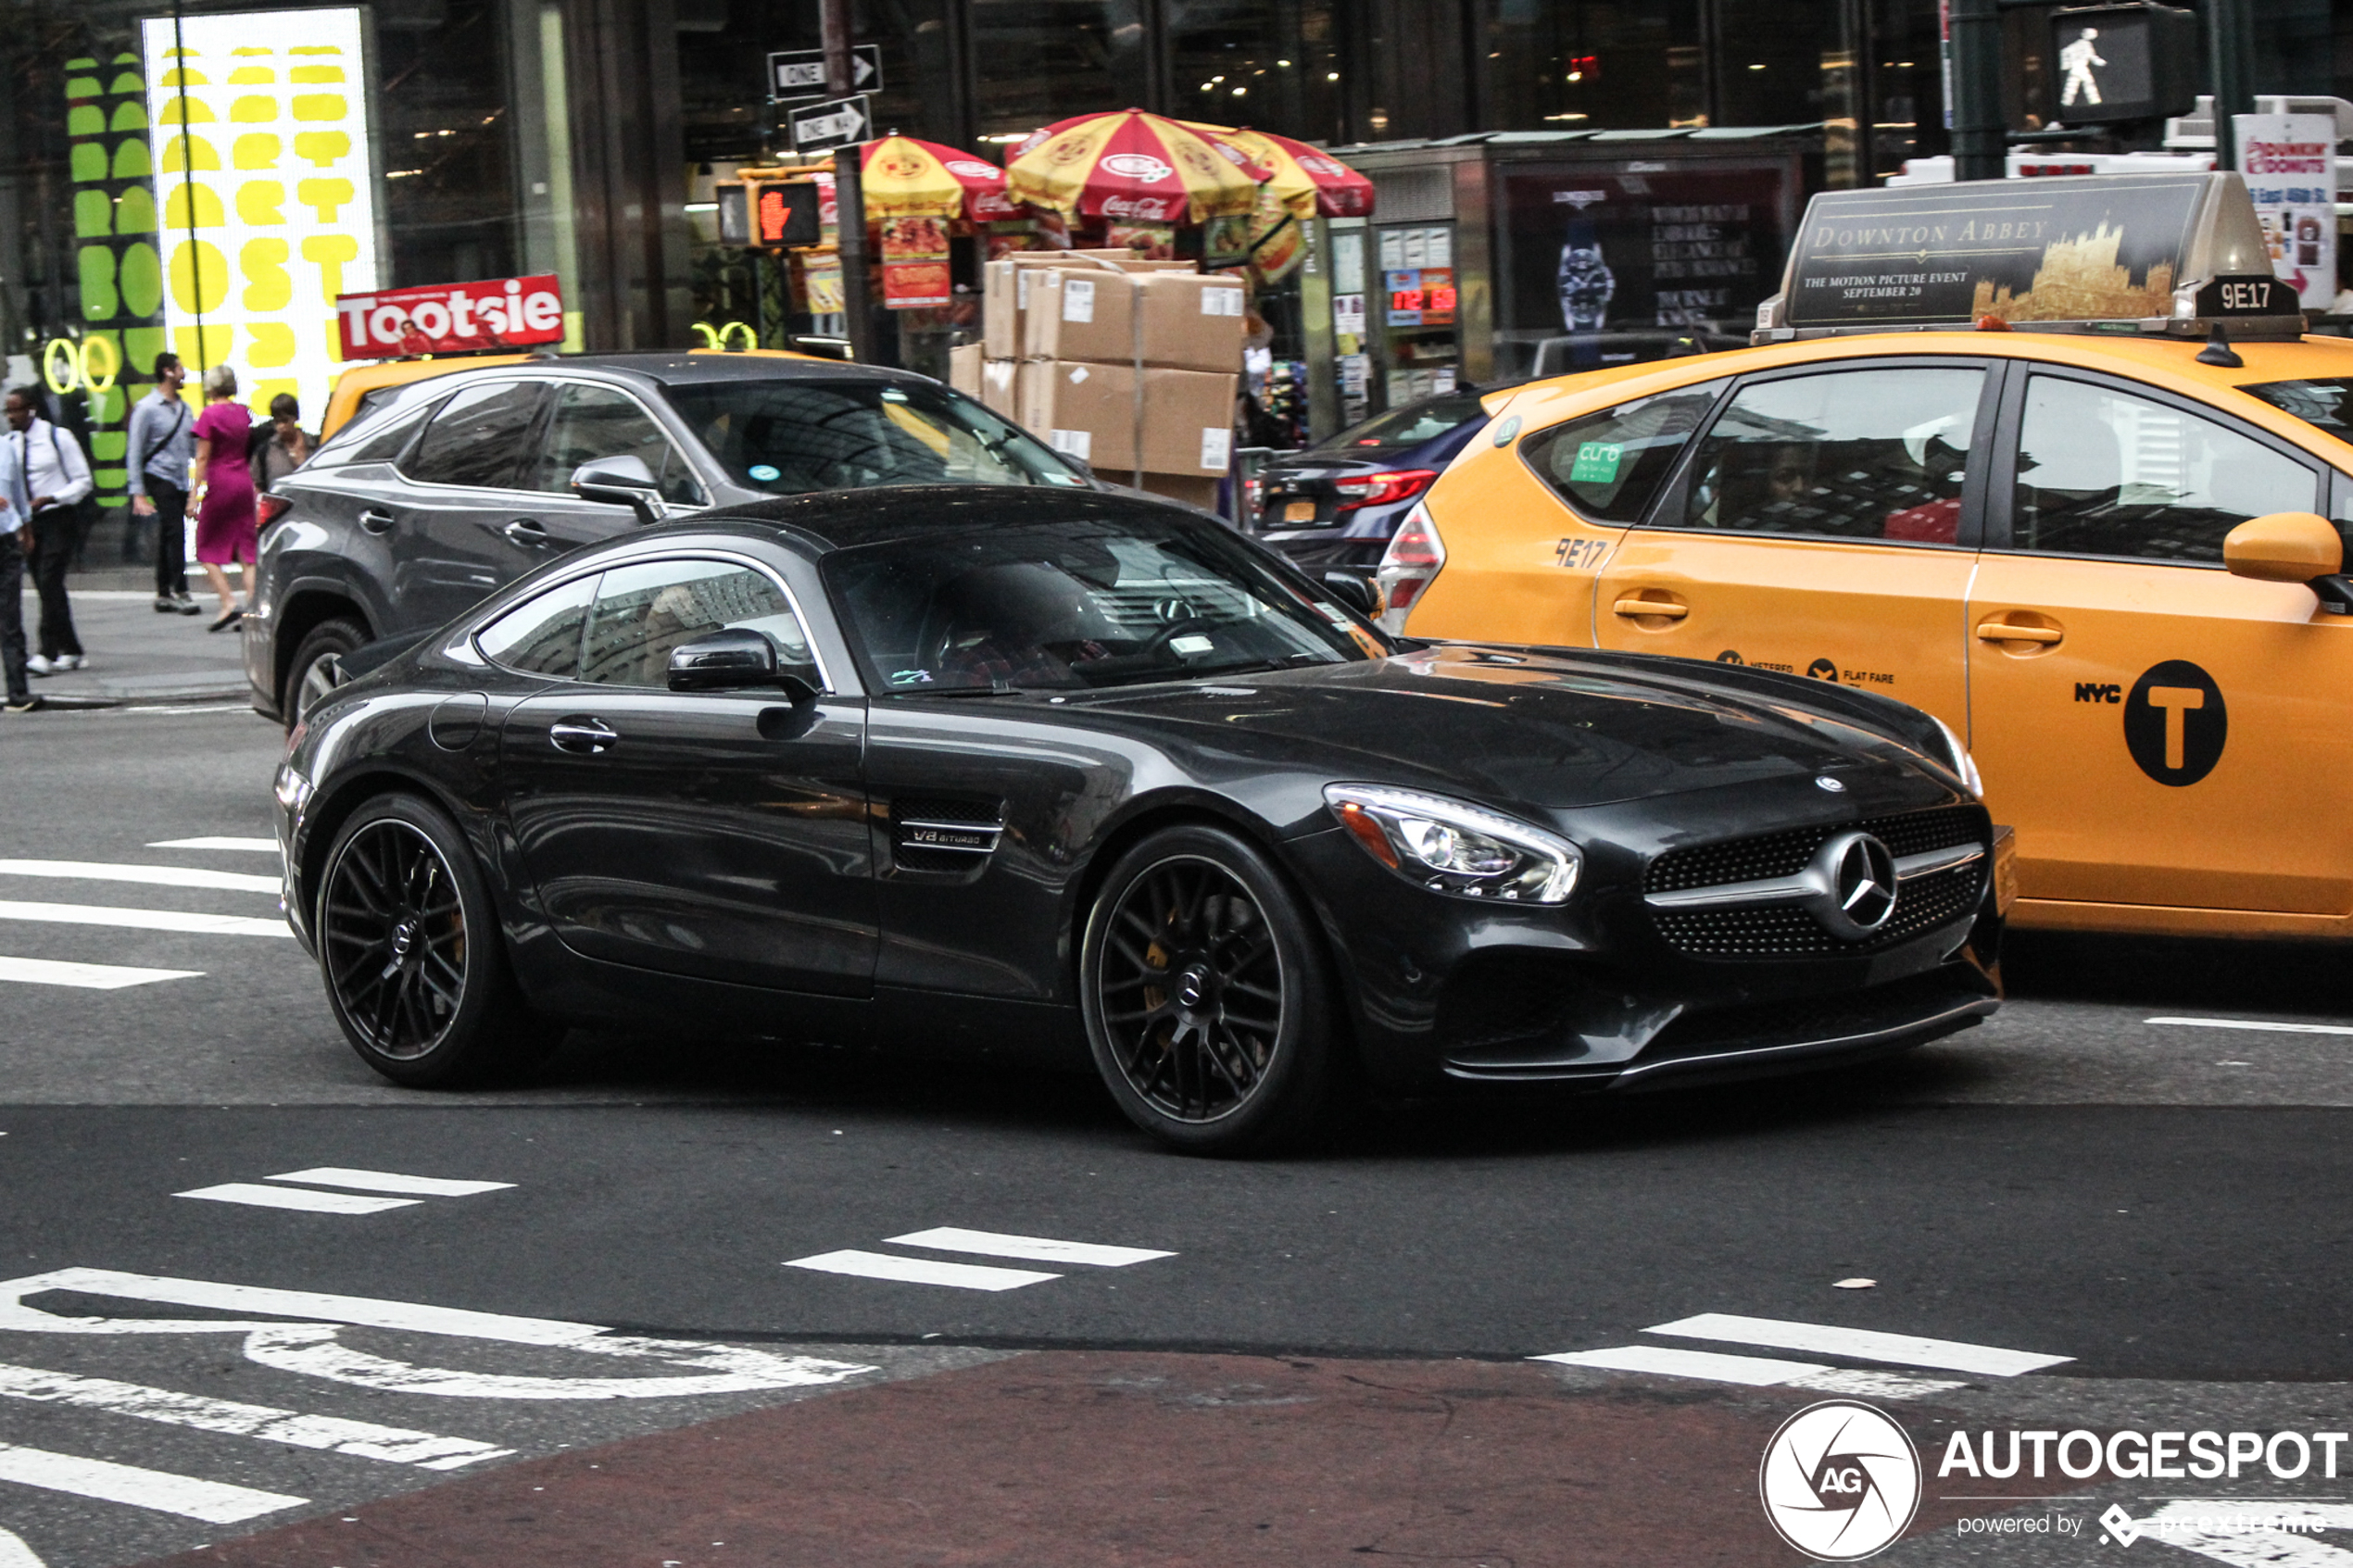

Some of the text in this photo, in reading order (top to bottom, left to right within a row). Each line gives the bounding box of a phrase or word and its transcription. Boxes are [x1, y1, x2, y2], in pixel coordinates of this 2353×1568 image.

[786, 65, 819, 84] ONE
[803, 119, 824, 139] ONE
[1813, 219, 2049, 249] DOWNTON ABBEY
[1804, 271, 1969, 289] THE MOTION PICTURE EVENT
[1843, 286, 1922, 299] SEPTEMBER 20
[2221, 282, 2271, 309] 9E17
[339, 279, 562, 346] Tootsie
[1579, 445, 1620, 462] curb
[1555, 537, 1607, 570] 9E17
[1843, 670, 1894, 684] FLAT FARE
[2074, 683, 2205, 770] NYC T
[912, 830, 980, 845] V8 BITURBO
